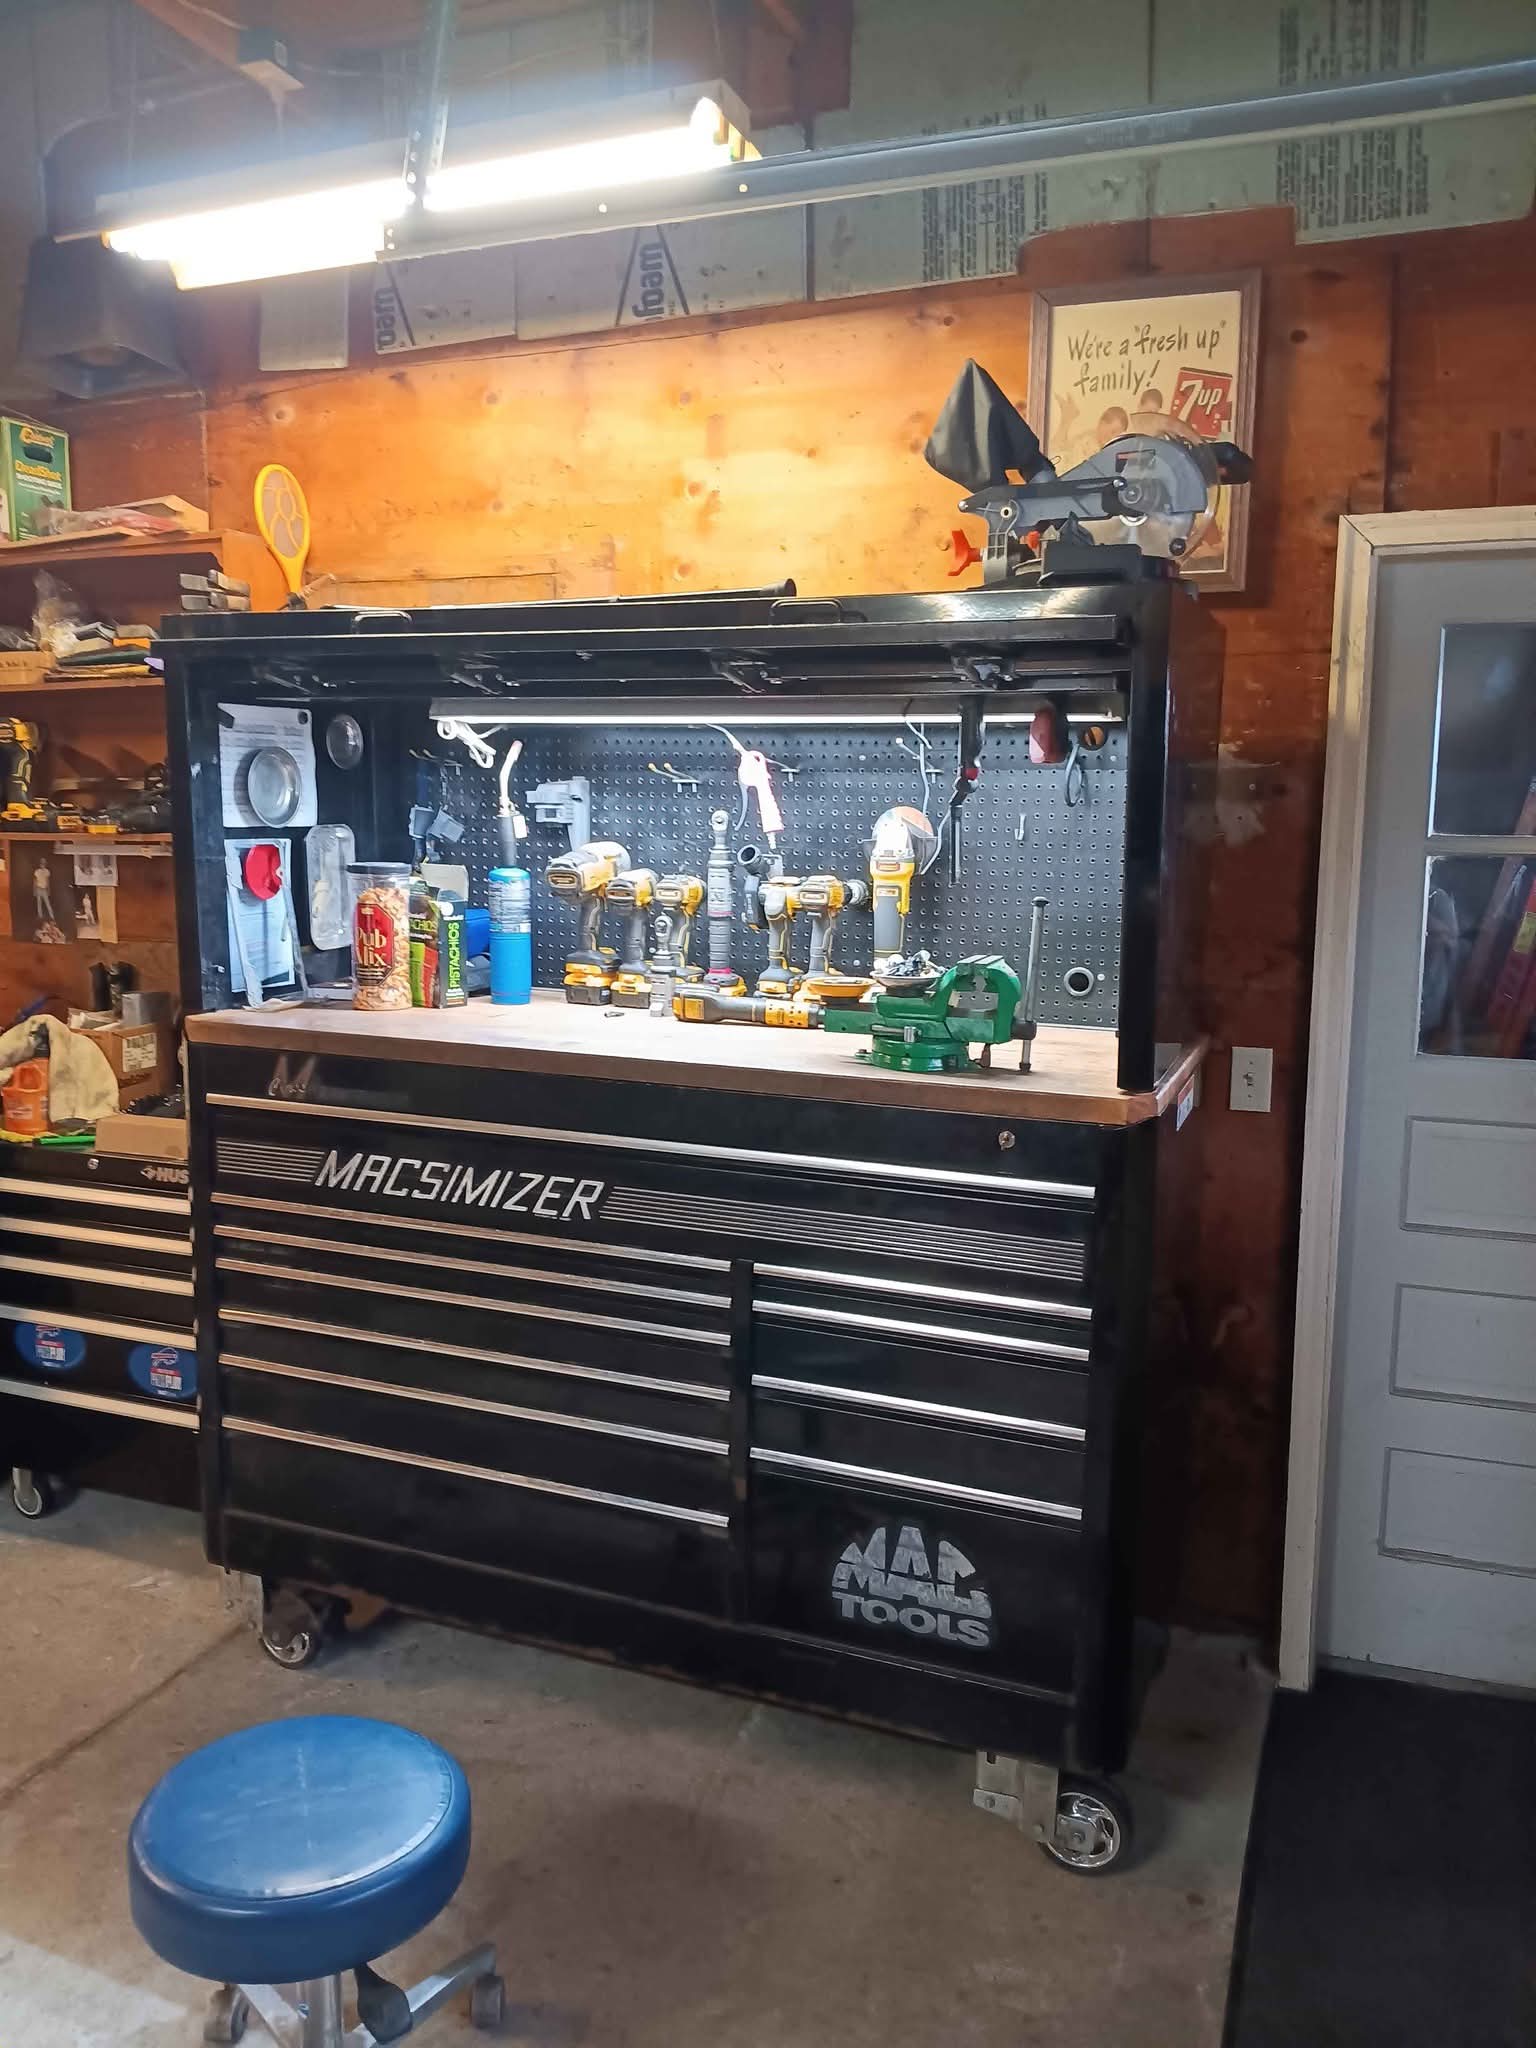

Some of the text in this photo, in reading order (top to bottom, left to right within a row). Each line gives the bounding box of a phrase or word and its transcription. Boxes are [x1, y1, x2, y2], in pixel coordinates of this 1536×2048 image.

[631, 242, 665, 321] foam
[1068, 330, 1112, 360] We're
[1119, 338, 1129, 356] a
[1073, 359, 1160, 396] family!
[448, 922, 460, 988] PISTACHIOS
[314, 1150, 605, 1220] MACSIMIZER
[832, 1525, 992, 1619] MAC
[832, 1591, 990, 1647] TOOLS
